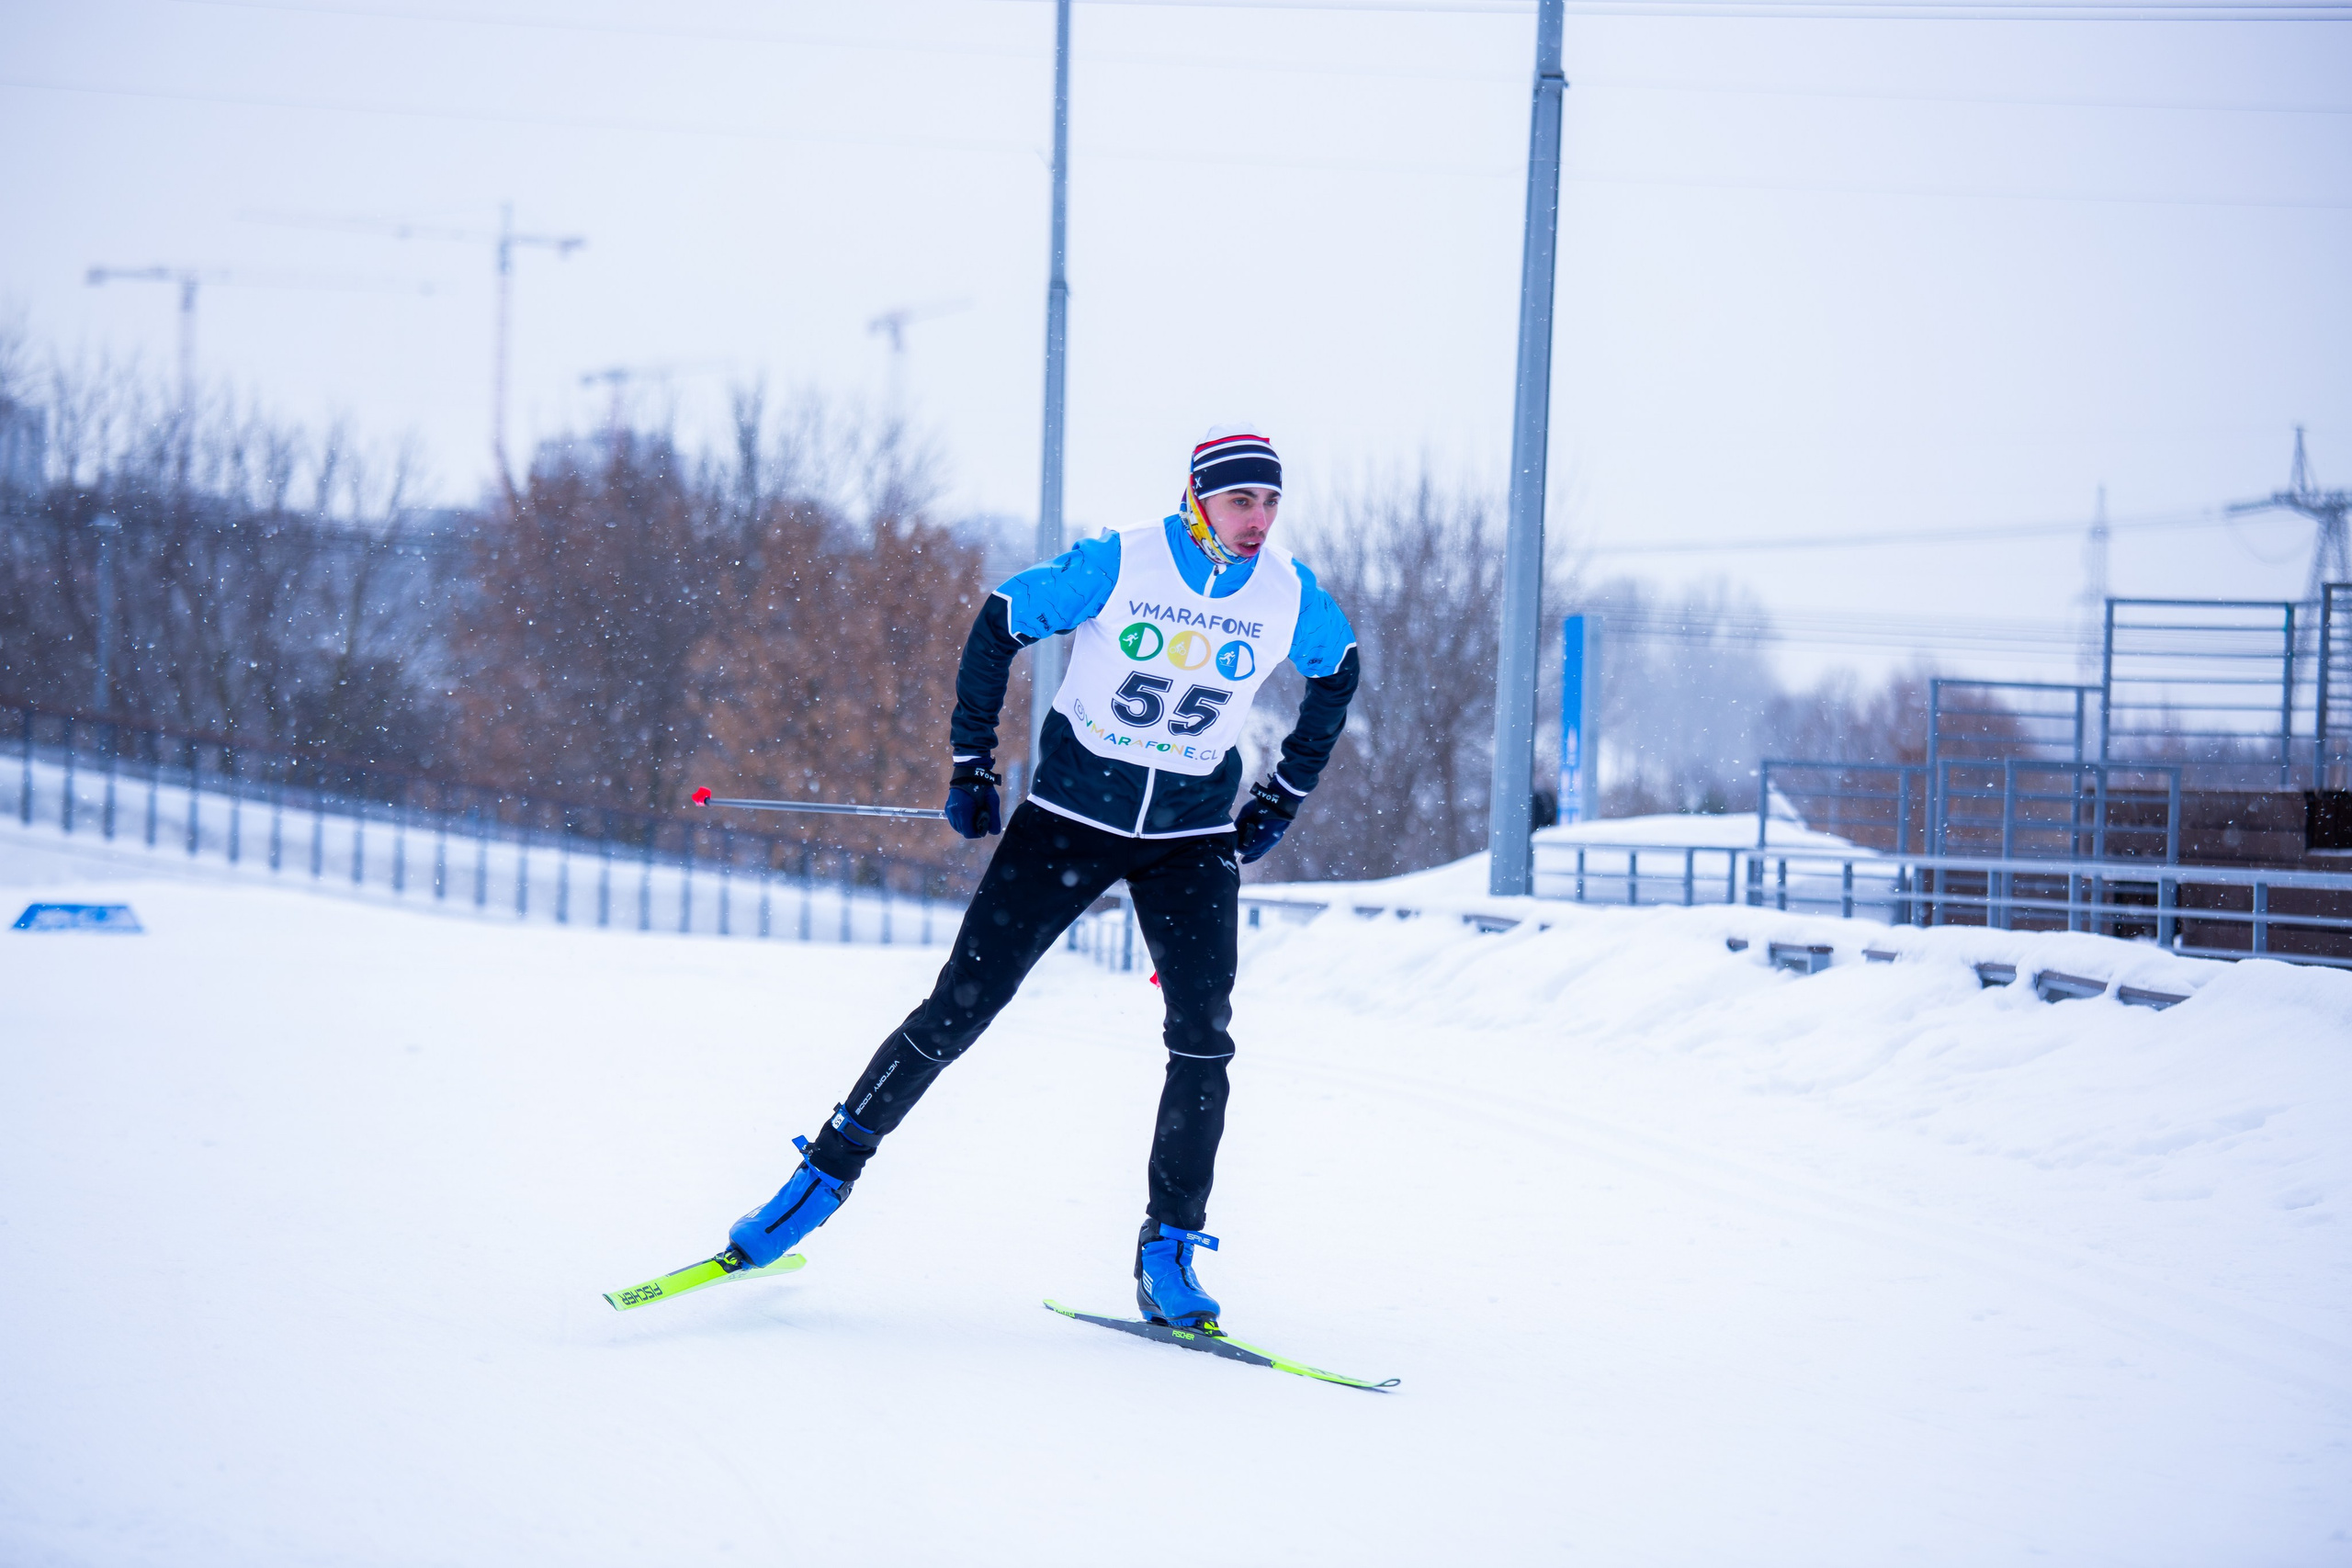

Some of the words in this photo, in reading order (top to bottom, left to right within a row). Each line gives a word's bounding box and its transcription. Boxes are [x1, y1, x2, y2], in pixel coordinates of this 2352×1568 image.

[1129, 600, 1264, 639] VMARAFONE
[1110, 671, 1233, 737] 55
[874, 1060, 900, 1093] VICTORY
[854, 1092, 873, 1115] CODE
[617, 1282, 663, 1306] FISCHER
[1171, 1329, 1195, 1341] FISCHER
